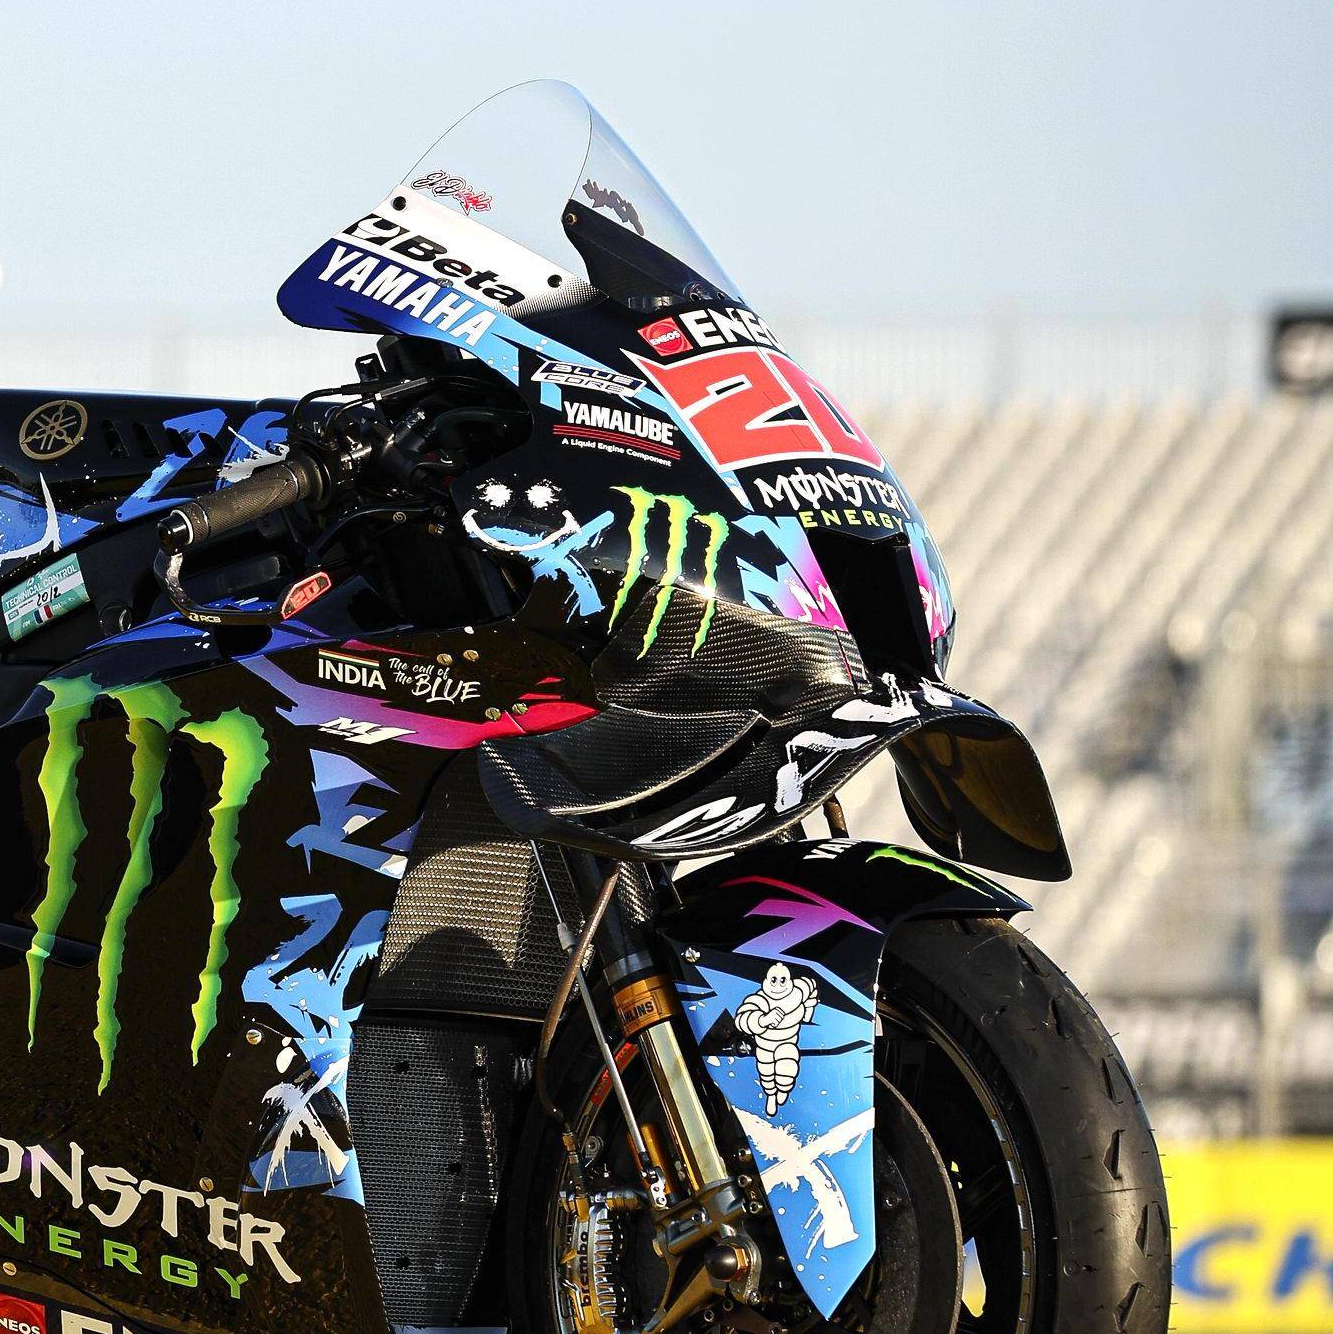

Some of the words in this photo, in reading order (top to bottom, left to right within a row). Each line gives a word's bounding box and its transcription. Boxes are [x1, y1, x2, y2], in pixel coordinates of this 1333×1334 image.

[389, 234, 526, 308] Beta
[318, 245, 497, 347] YAMAHA
[648, 331, 681, 347] ENEOS
[544, 373, 625, 394] CORE
[551, 363, 635, 386] BLUE
[563, 400, 674, 446] YAMALUBE
[570, 439, 597, 449] Liquid
[597, 441, 625, 455] Engine
[625, 448, 672, 467] Component
[753, 466, 911, 520] MONSTER
[798, 509, 905, 532] ENERGY
[43, 564, 77, 588] CONTROL
[318, 658, 387, 690] INDIA
[389, 657, 410, 671] The
[412, 664, 435, 675] call
[437, 666, 451, 680] of
[411, 673, 481, 705] BLUE
